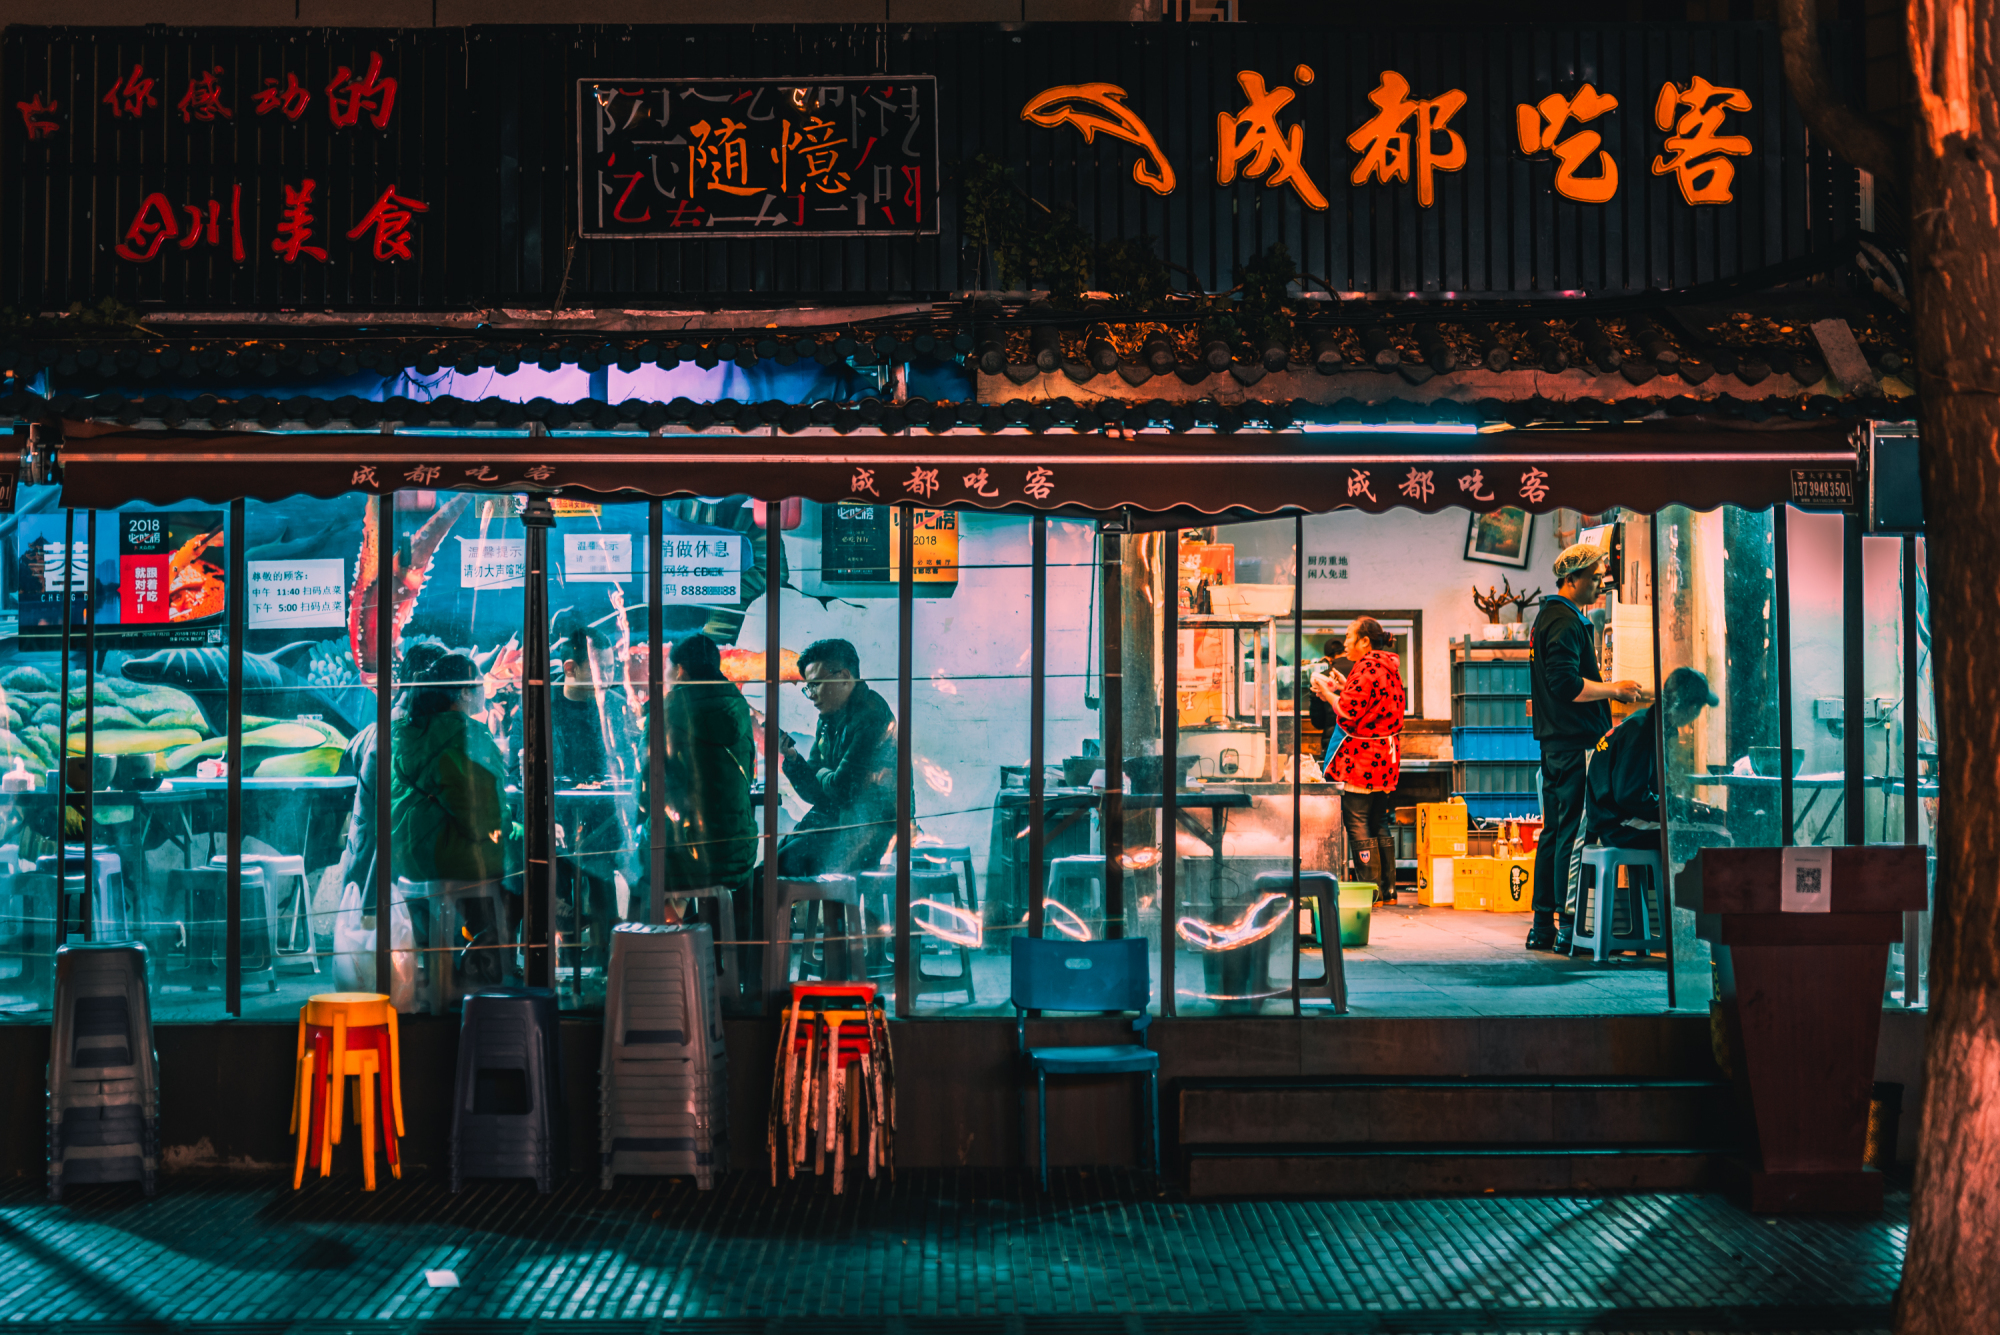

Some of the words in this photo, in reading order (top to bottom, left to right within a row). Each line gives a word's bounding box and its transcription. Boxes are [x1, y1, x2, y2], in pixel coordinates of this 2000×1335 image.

[1216, 64, 1753, 210] 成都吃客
[351, 464, 556, 488] 成都吃客
[851, 466, 1055, 500] 成都吃客
[1347, 466, 1550, 504] 成都吃客
[1793, 481, 1852, 497] 13739483501
[129, 519, 160, 532] 2018
[894, 509, 956, 530] 吃榜
[913, 535, 937, 546] 2018
[468, 545, 523, 559] 温馨提示
[1307, 555, 1349, 566] 厨房重地
[1307, 568, 1349, 580] 闲人免进
[146, 566, 158, 602] 跟着吃
[41, 593, 76, 603] CHEG
[252, 587, 271, 598] 中午
[277, 588, 301, 596] 11:40
[303, 585, 342, 596] 扫码点菜
[252, 602, 272, 613] 下午
[278, 603, 298, 613] 5:00
[300, 601, 342, 612] 扫码点菜
